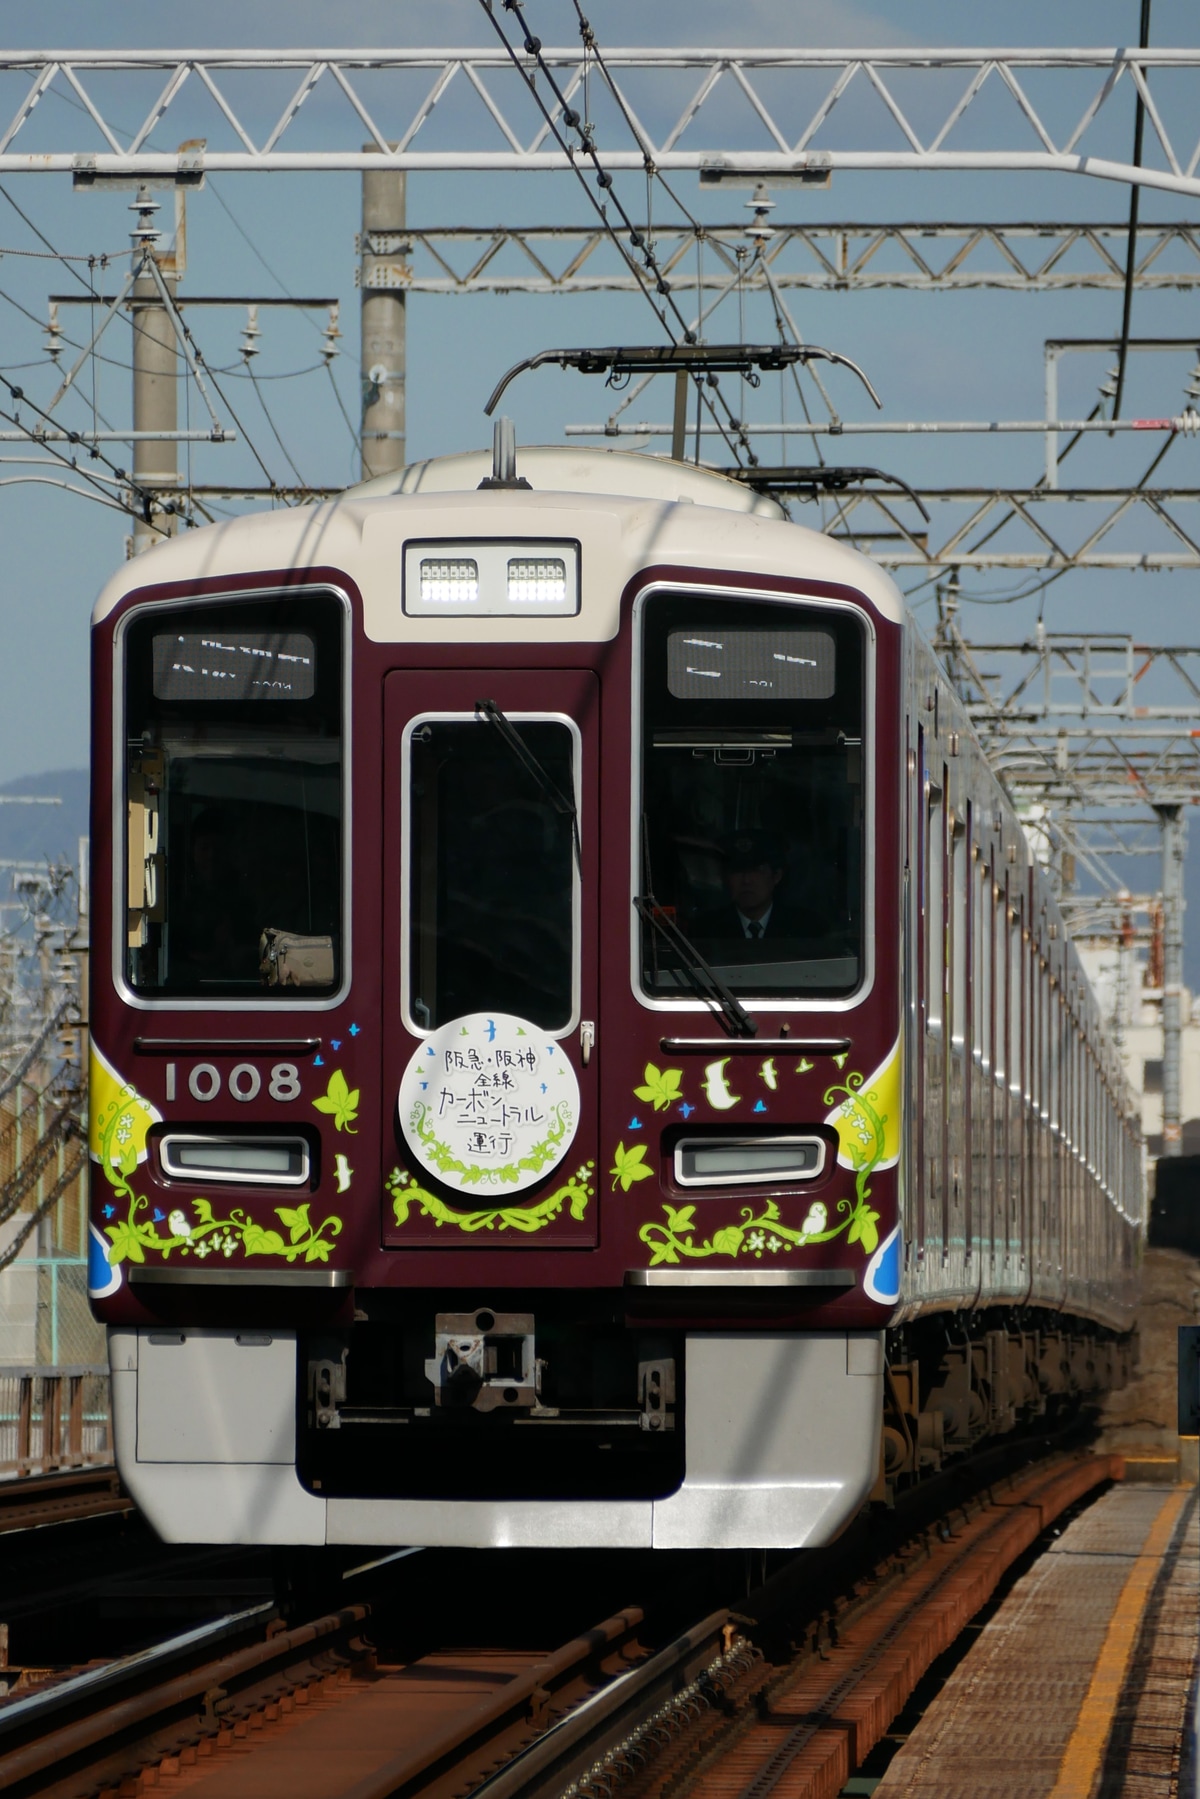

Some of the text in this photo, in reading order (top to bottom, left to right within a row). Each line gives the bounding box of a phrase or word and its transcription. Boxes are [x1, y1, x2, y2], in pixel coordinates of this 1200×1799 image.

[166, 1063, 301, 1101] 1008
[474, 1070, 514, 1090] 全線
[439, 1088, 502, 1115] カーボン
[457, 1104, 543, 1127] ニュートラル
[468, 1132, 512, 1154] 運行
